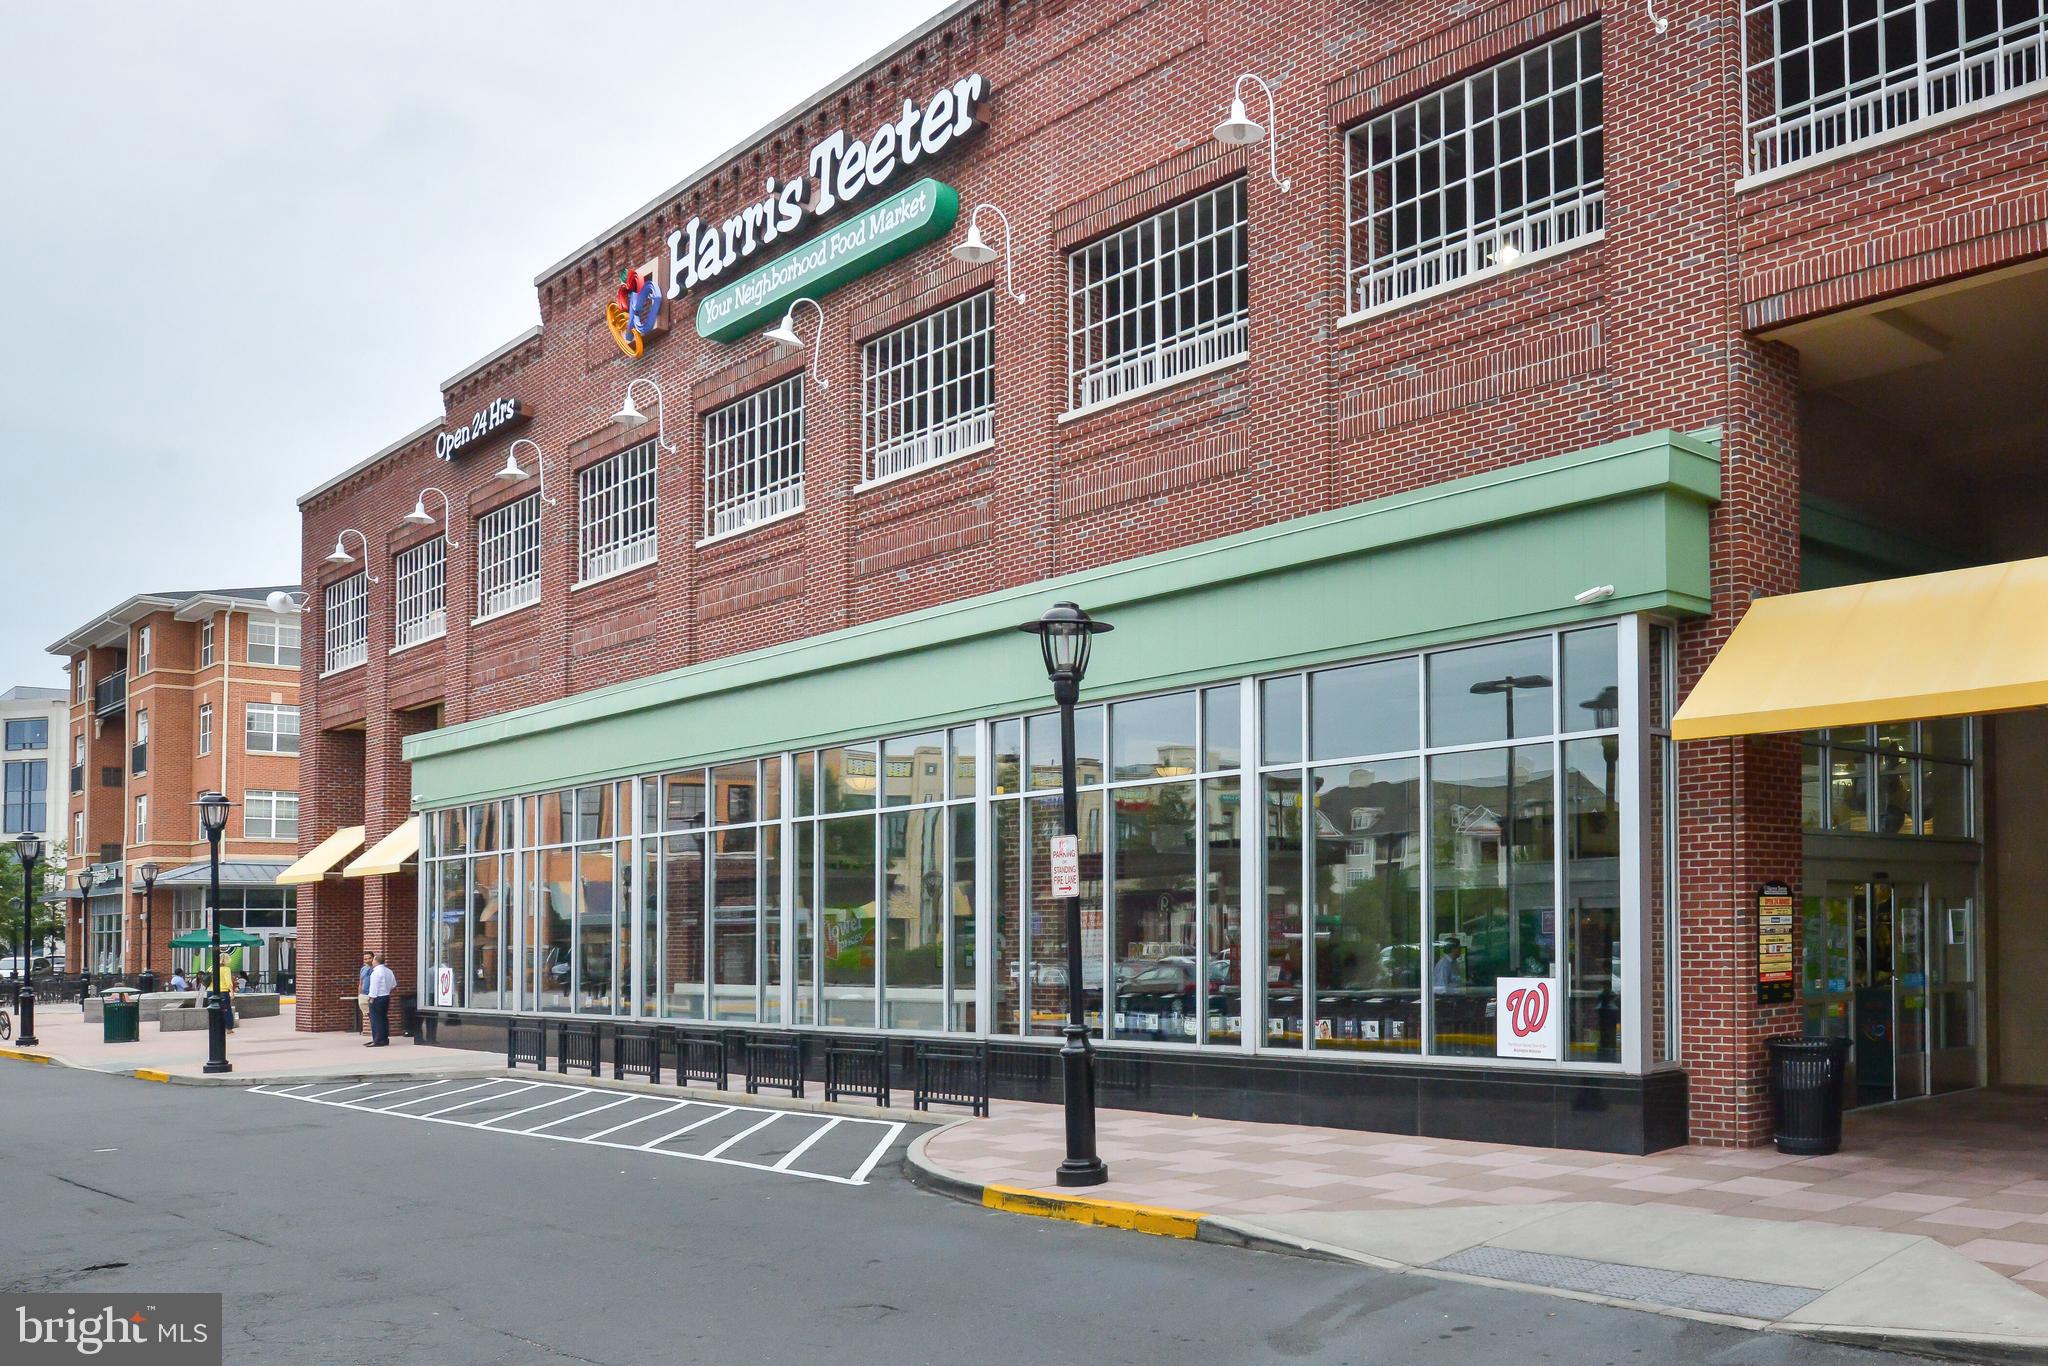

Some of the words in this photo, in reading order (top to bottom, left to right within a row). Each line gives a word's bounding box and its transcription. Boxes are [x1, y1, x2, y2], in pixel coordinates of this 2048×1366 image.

[667, 176, 803, 299] Harris
[810, 73, 982, 215] Teeter
[704, 296, 733, 324] Your
[735, 239, 828, 310] Neighborhood
[830, 219, 866, 260] Food
[869, 190, 926, 240] Market
[436, 426, 470, 461] Open
[472, 409, 488, 440] 24
[489, 397, 515, 430] Hrs
[1052, 849, 1076, 858] PARKING
[1053, 865, 1077, 874] STANDING
[1053, 876, 1064, 885] FIRE
[1065, 875, 1077, 885] LANE
[1506, 982, 1549, 1037] W
